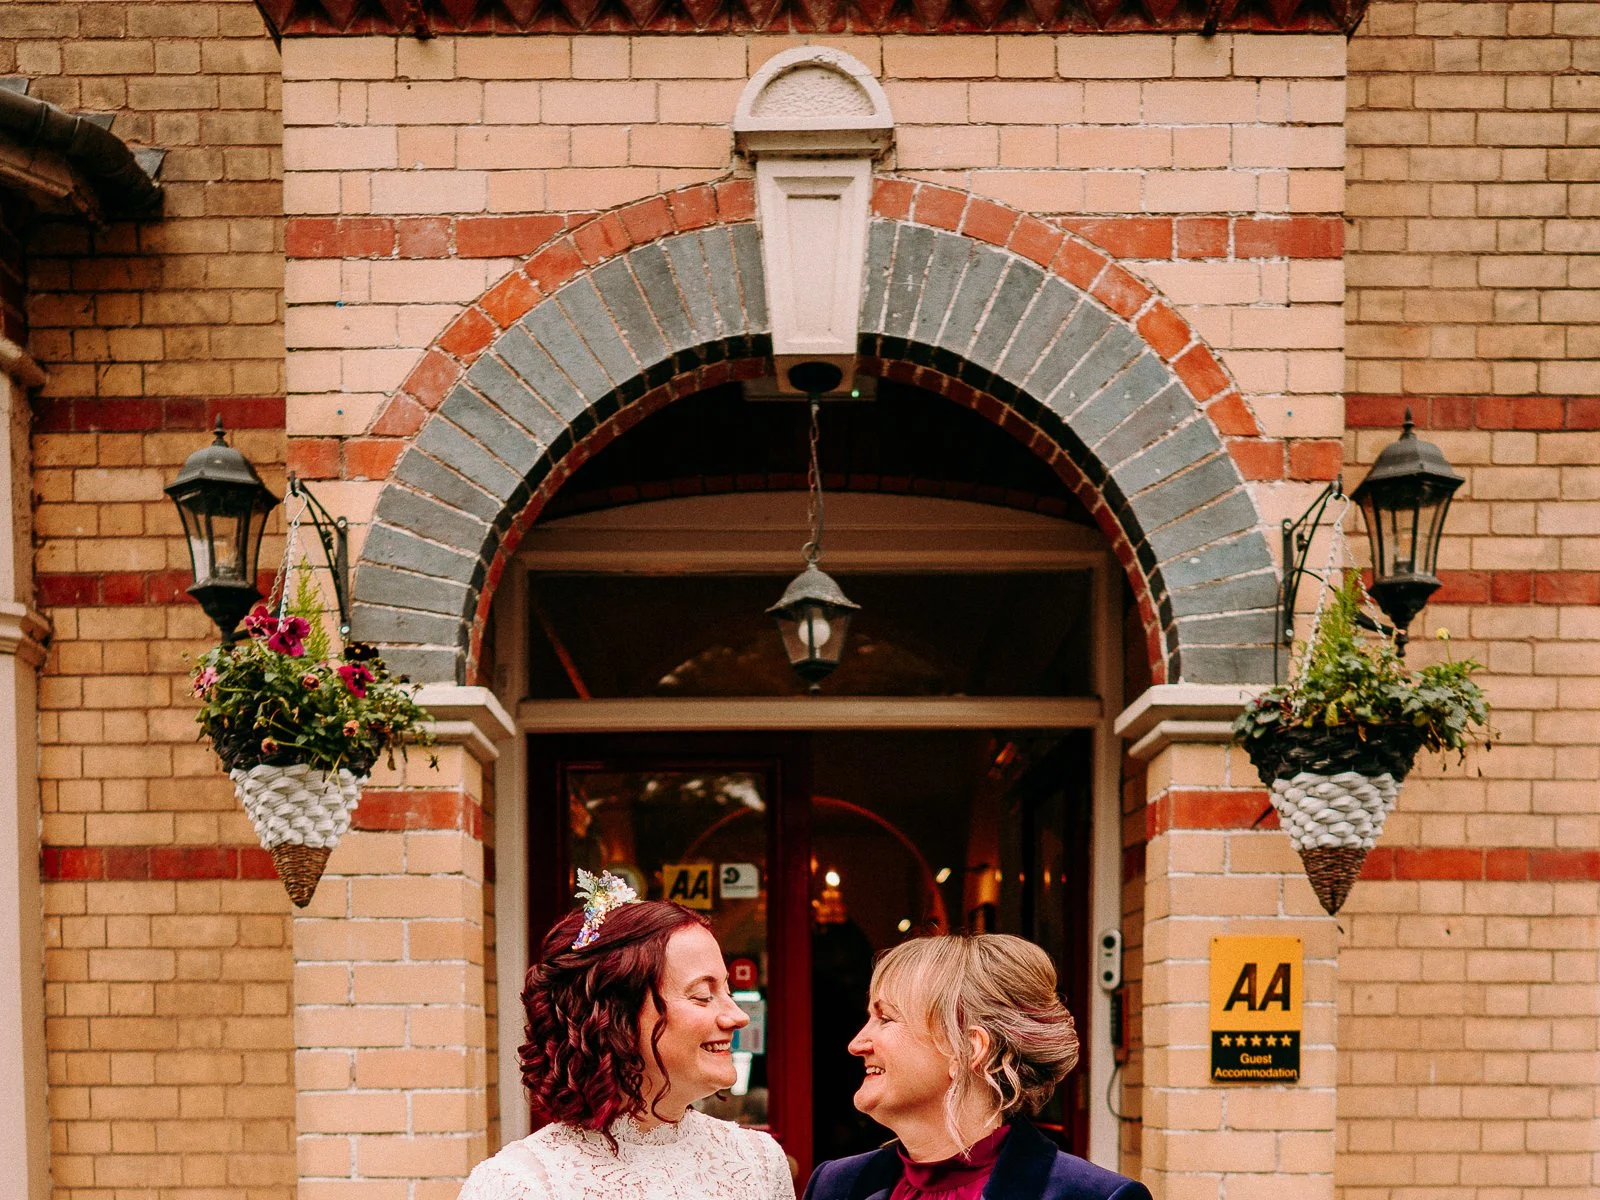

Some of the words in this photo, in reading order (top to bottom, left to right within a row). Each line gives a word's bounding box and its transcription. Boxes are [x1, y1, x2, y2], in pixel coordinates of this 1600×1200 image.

[668, 869, 709, 900] AA
[1222, 962, 1291, 1011] AA
[1240, 1053, 1272, 1064] Guest
[1214, 1067, 1297, 1078] Accommodation
